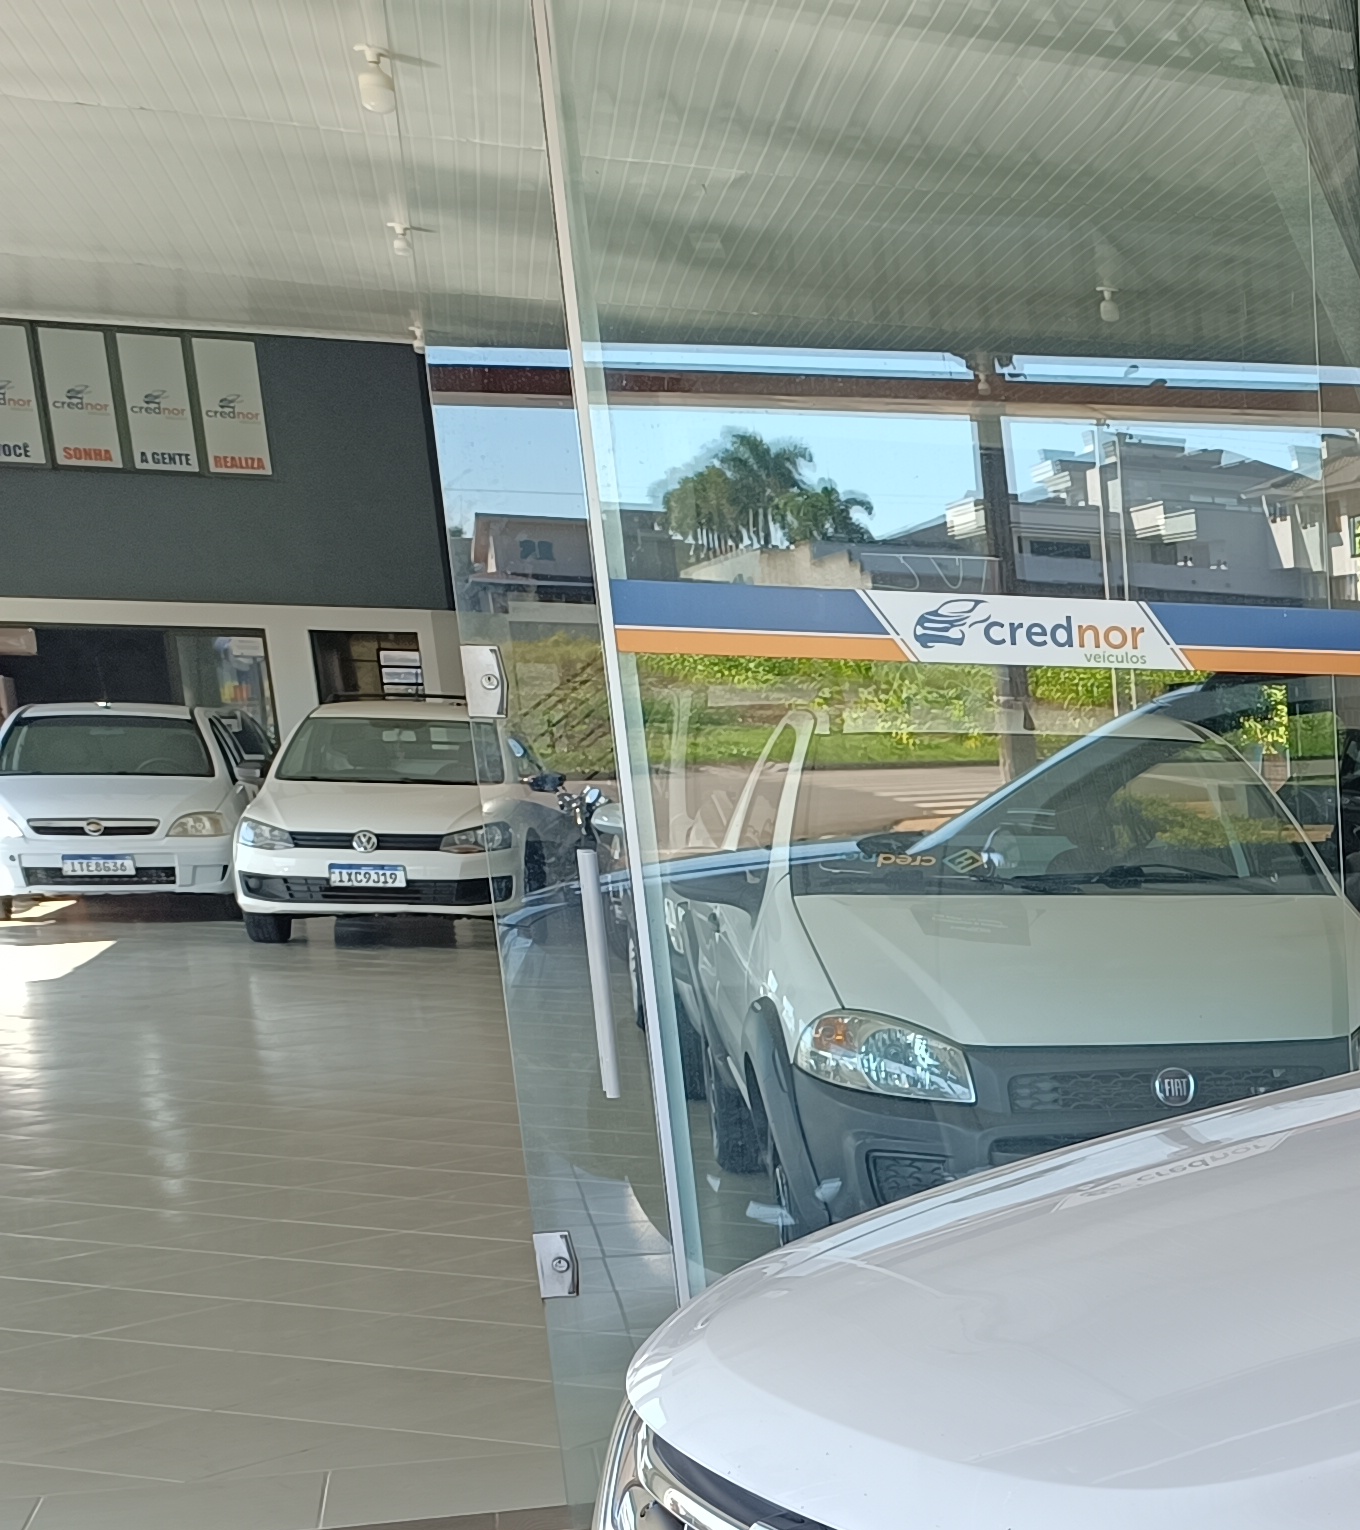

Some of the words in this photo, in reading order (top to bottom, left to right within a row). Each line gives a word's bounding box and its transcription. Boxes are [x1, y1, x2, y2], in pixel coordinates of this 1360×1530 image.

[52, 398, 110, 412] crednor
[130, 403, 187, 417] crednor
[205, 407, 260, 421] crednor
[140, 451, 150, 464] A
[151, 452, 192, 466] GENTE
[213, 455, 265, 470] REALIZA
[983, 615, 1145, 650] crednor
[1084, 650, 1147, 665] veículos
[1164, 1078, 1187, 1097] FIAT
